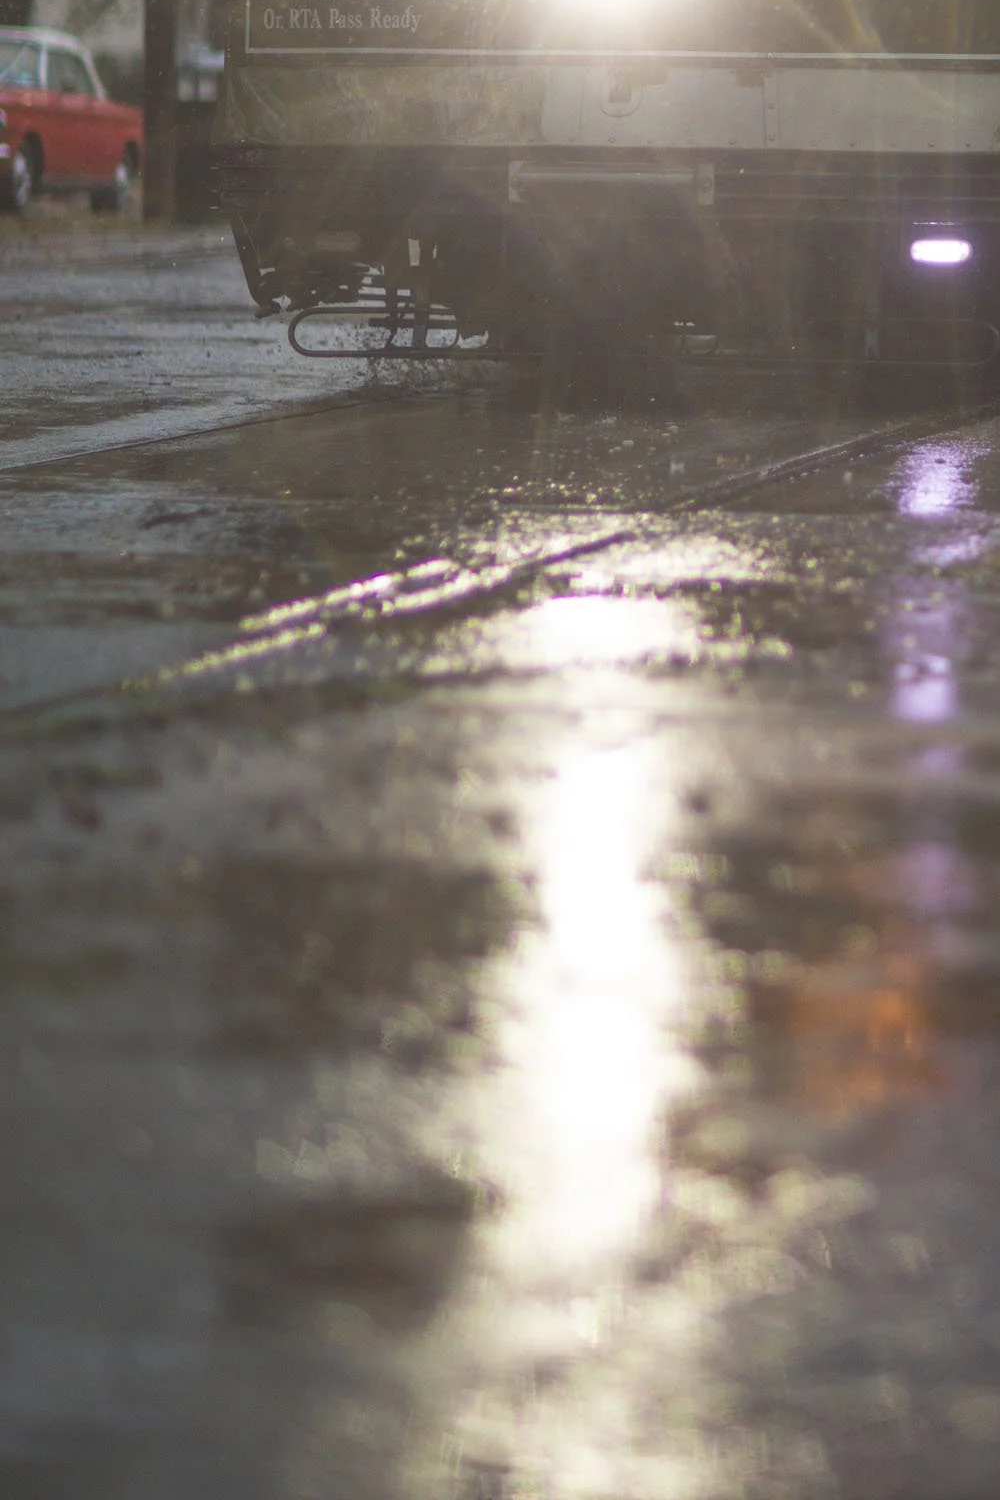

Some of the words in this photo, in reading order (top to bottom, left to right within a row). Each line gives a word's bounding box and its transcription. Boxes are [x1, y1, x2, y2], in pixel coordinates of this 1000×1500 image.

[289, 8, 322, 29] RTA
[329, 8, 362, 29] Pass
[370, 5, 421, 33] Ready
